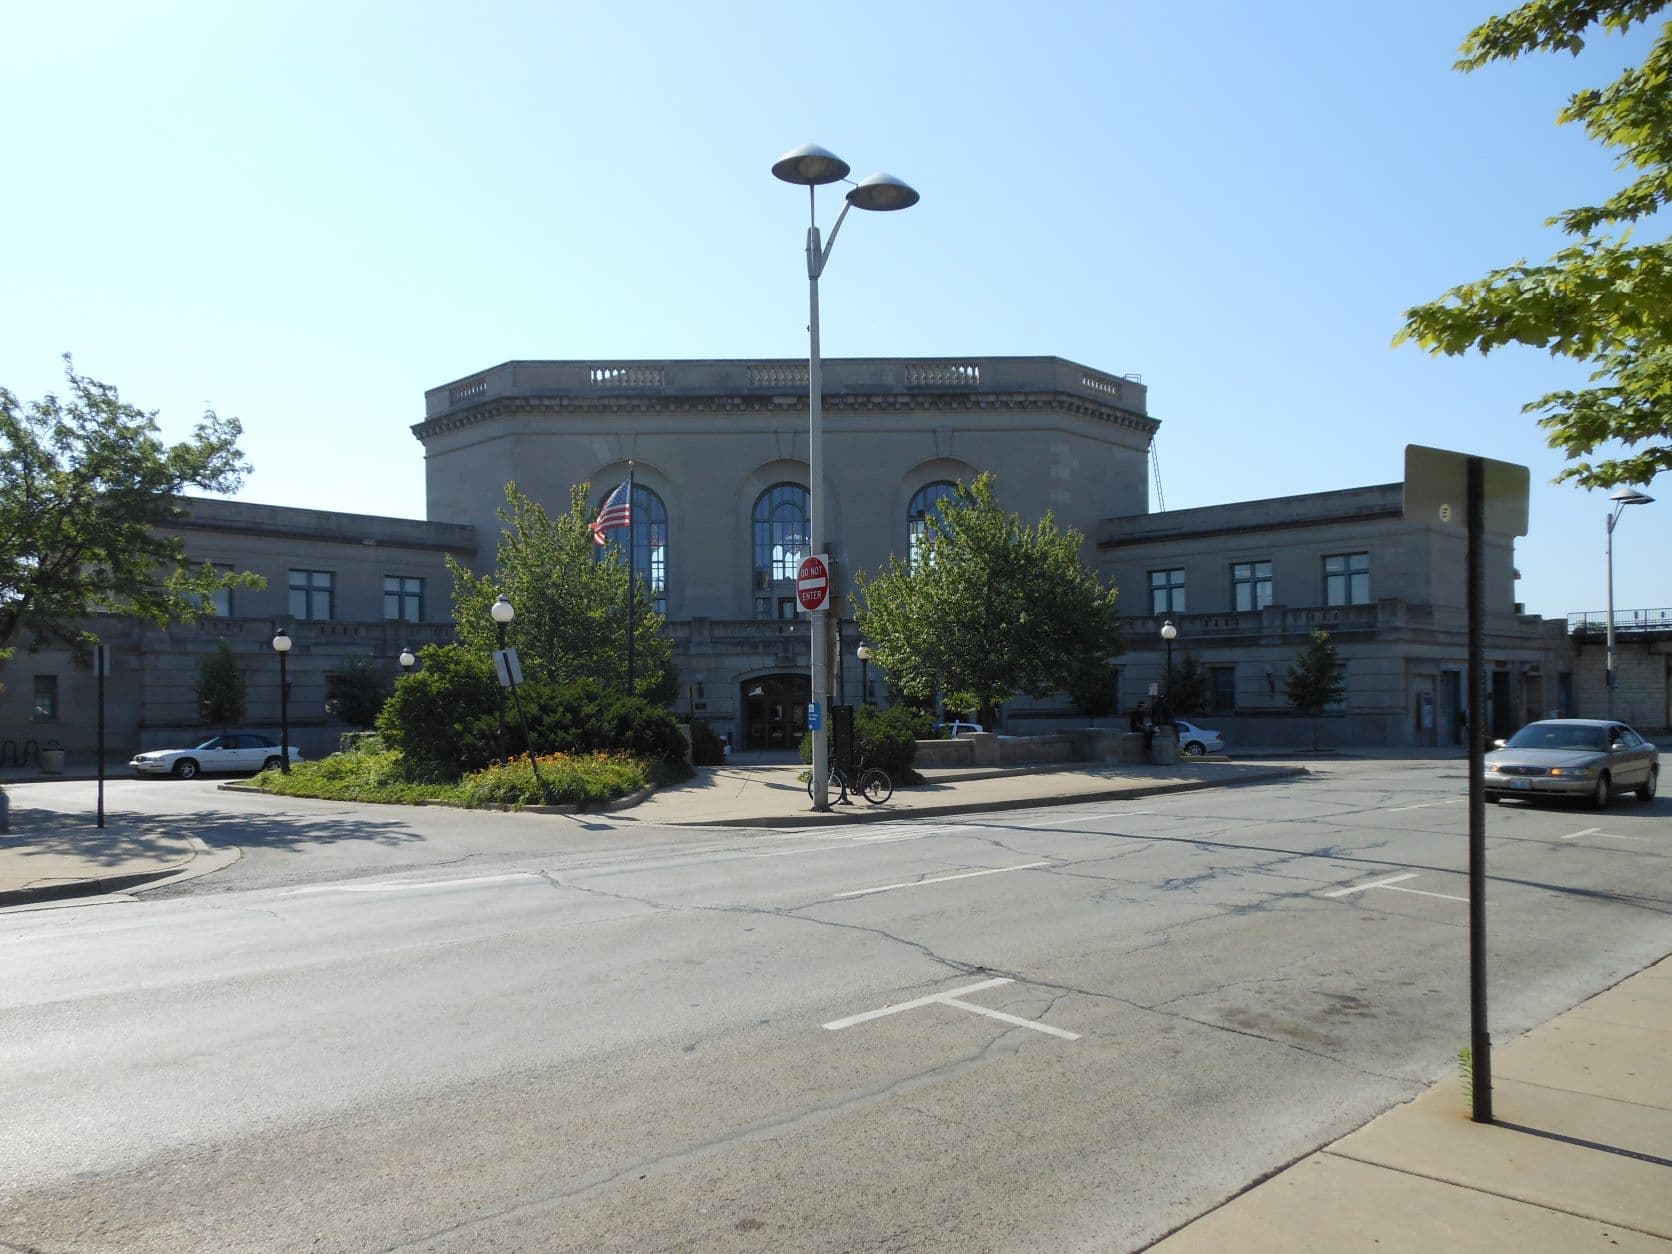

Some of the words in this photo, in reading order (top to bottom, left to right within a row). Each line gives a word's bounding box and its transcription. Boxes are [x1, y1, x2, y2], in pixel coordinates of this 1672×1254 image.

[800, 568, 809, 578] DO
[810, 566, 823, 577] NOT
[802, 591, 822, 600] ENTER
